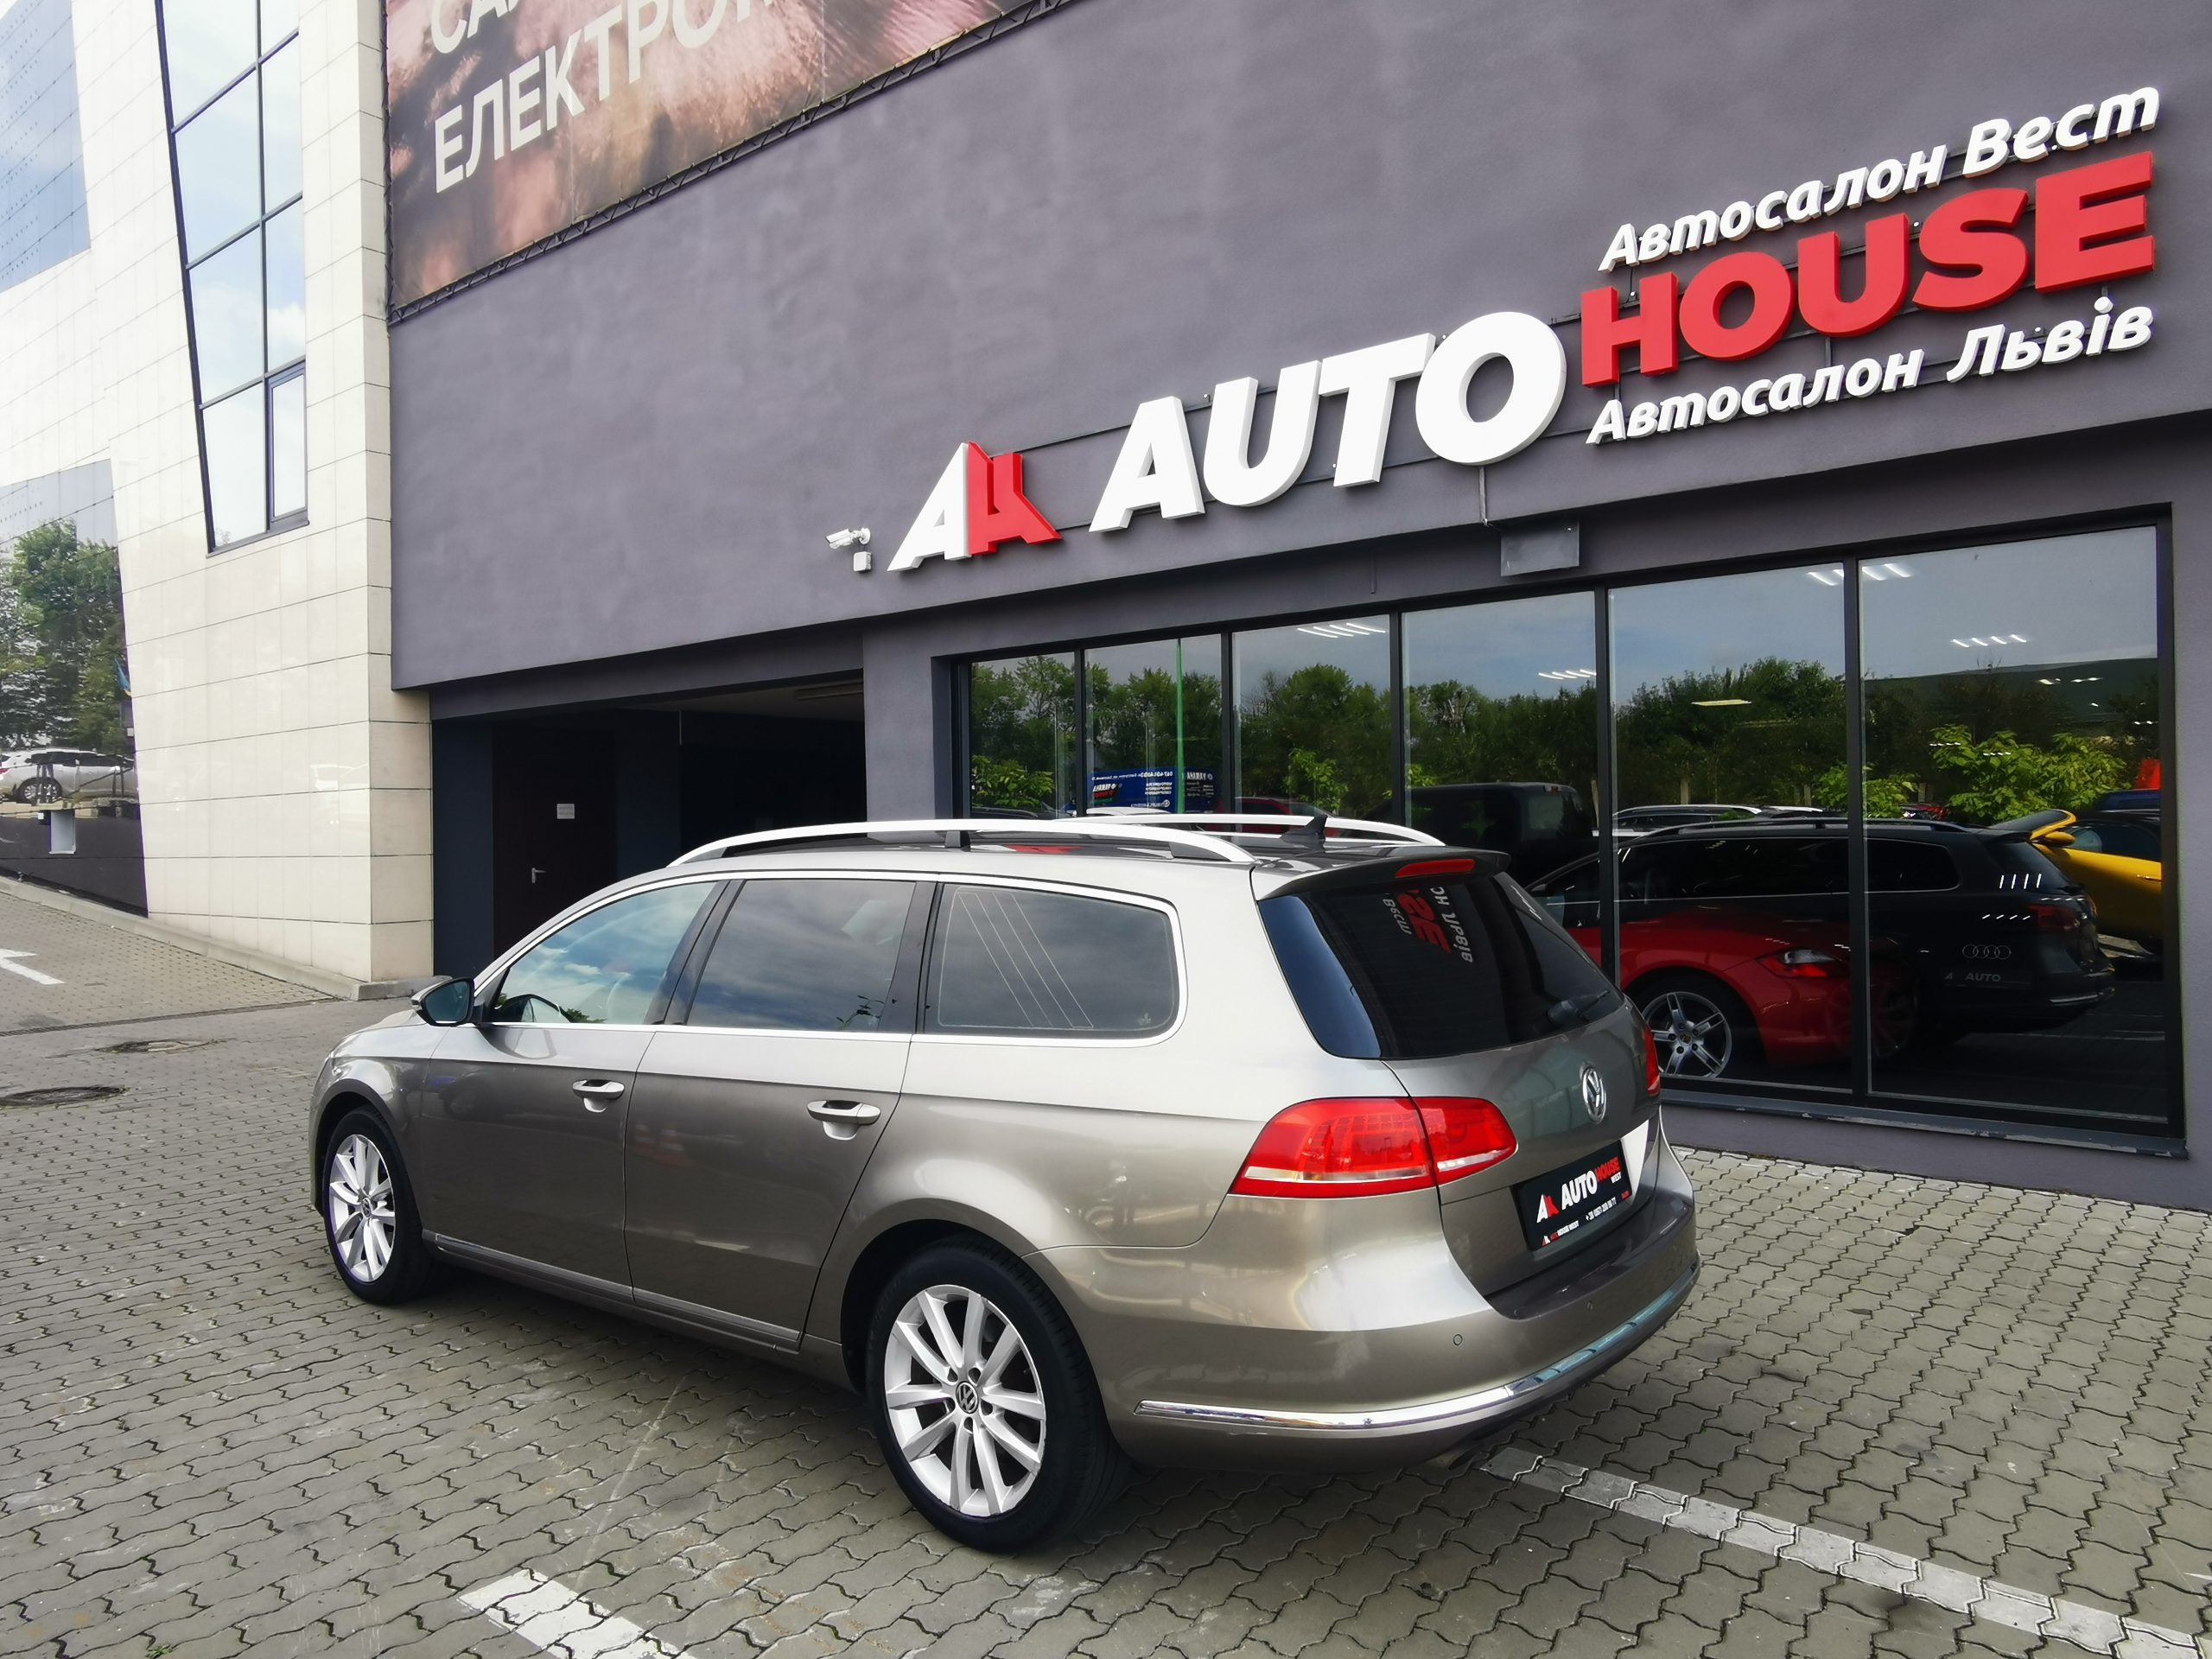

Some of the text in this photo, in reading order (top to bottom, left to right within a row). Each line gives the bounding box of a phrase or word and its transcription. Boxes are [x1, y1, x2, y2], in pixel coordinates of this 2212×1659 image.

[435, 0, 775, 194] ЕЛЕКТРО
[1598, 86, 2160, 273] Автосалон Вест
[1580, 151, 2155, 388] HOUSE
[1089, 310, 1567, 533] AUTO
[1586, 296, 2153, 446] Автосалон Львів
[1561, 1170, 1597, 1210] AUTO
[1594, 1156, 1621, 1182] HOUSE
